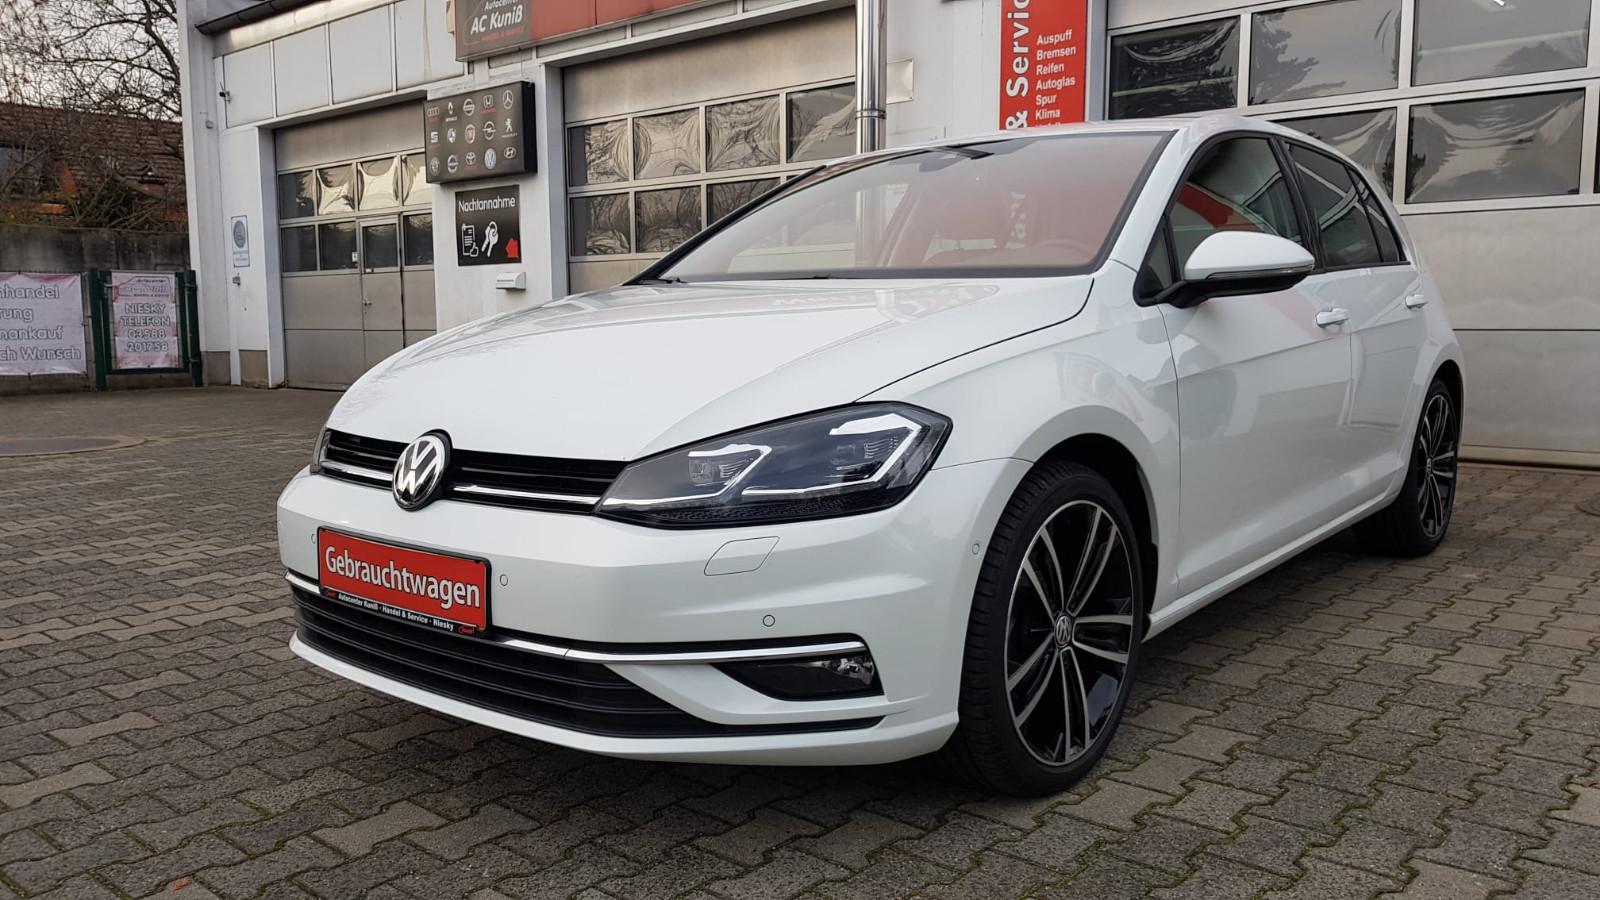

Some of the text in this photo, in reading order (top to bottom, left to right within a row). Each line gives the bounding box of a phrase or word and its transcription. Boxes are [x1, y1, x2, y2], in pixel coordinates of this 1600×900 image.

[484, 0, 518, 11] Autocente
[470, 14, 488, 35] AC
[490, 4, 523, 31] Kuniß
[1036, 29, 1073, 46] Auspuff
[1036, 46, 1077, 61] Bremsen
[1036, 62, 1065, 76] Reifen
[1035, 76, 1076, 91] Autoglas
[1035, 94, 1057, 107] Spur
[1005, 110, 1028, 129] &
[1035, 109, 1061, 121] Klima
[458, 196, 516, 213] Nachtannahme
[124, 302, 166, 314] NIESKY
[120, 315, 171, 327] TELEFON
[21, 345, 82, 360] Wunsch
[325, 546, 480, 610] Gebrauchtwagen
[382, 605, 400, 617] Handel
[401, 610, 406, 618] &
[407, 612, 428, 624] Service
[432, 618, 454, 631] Niesky
